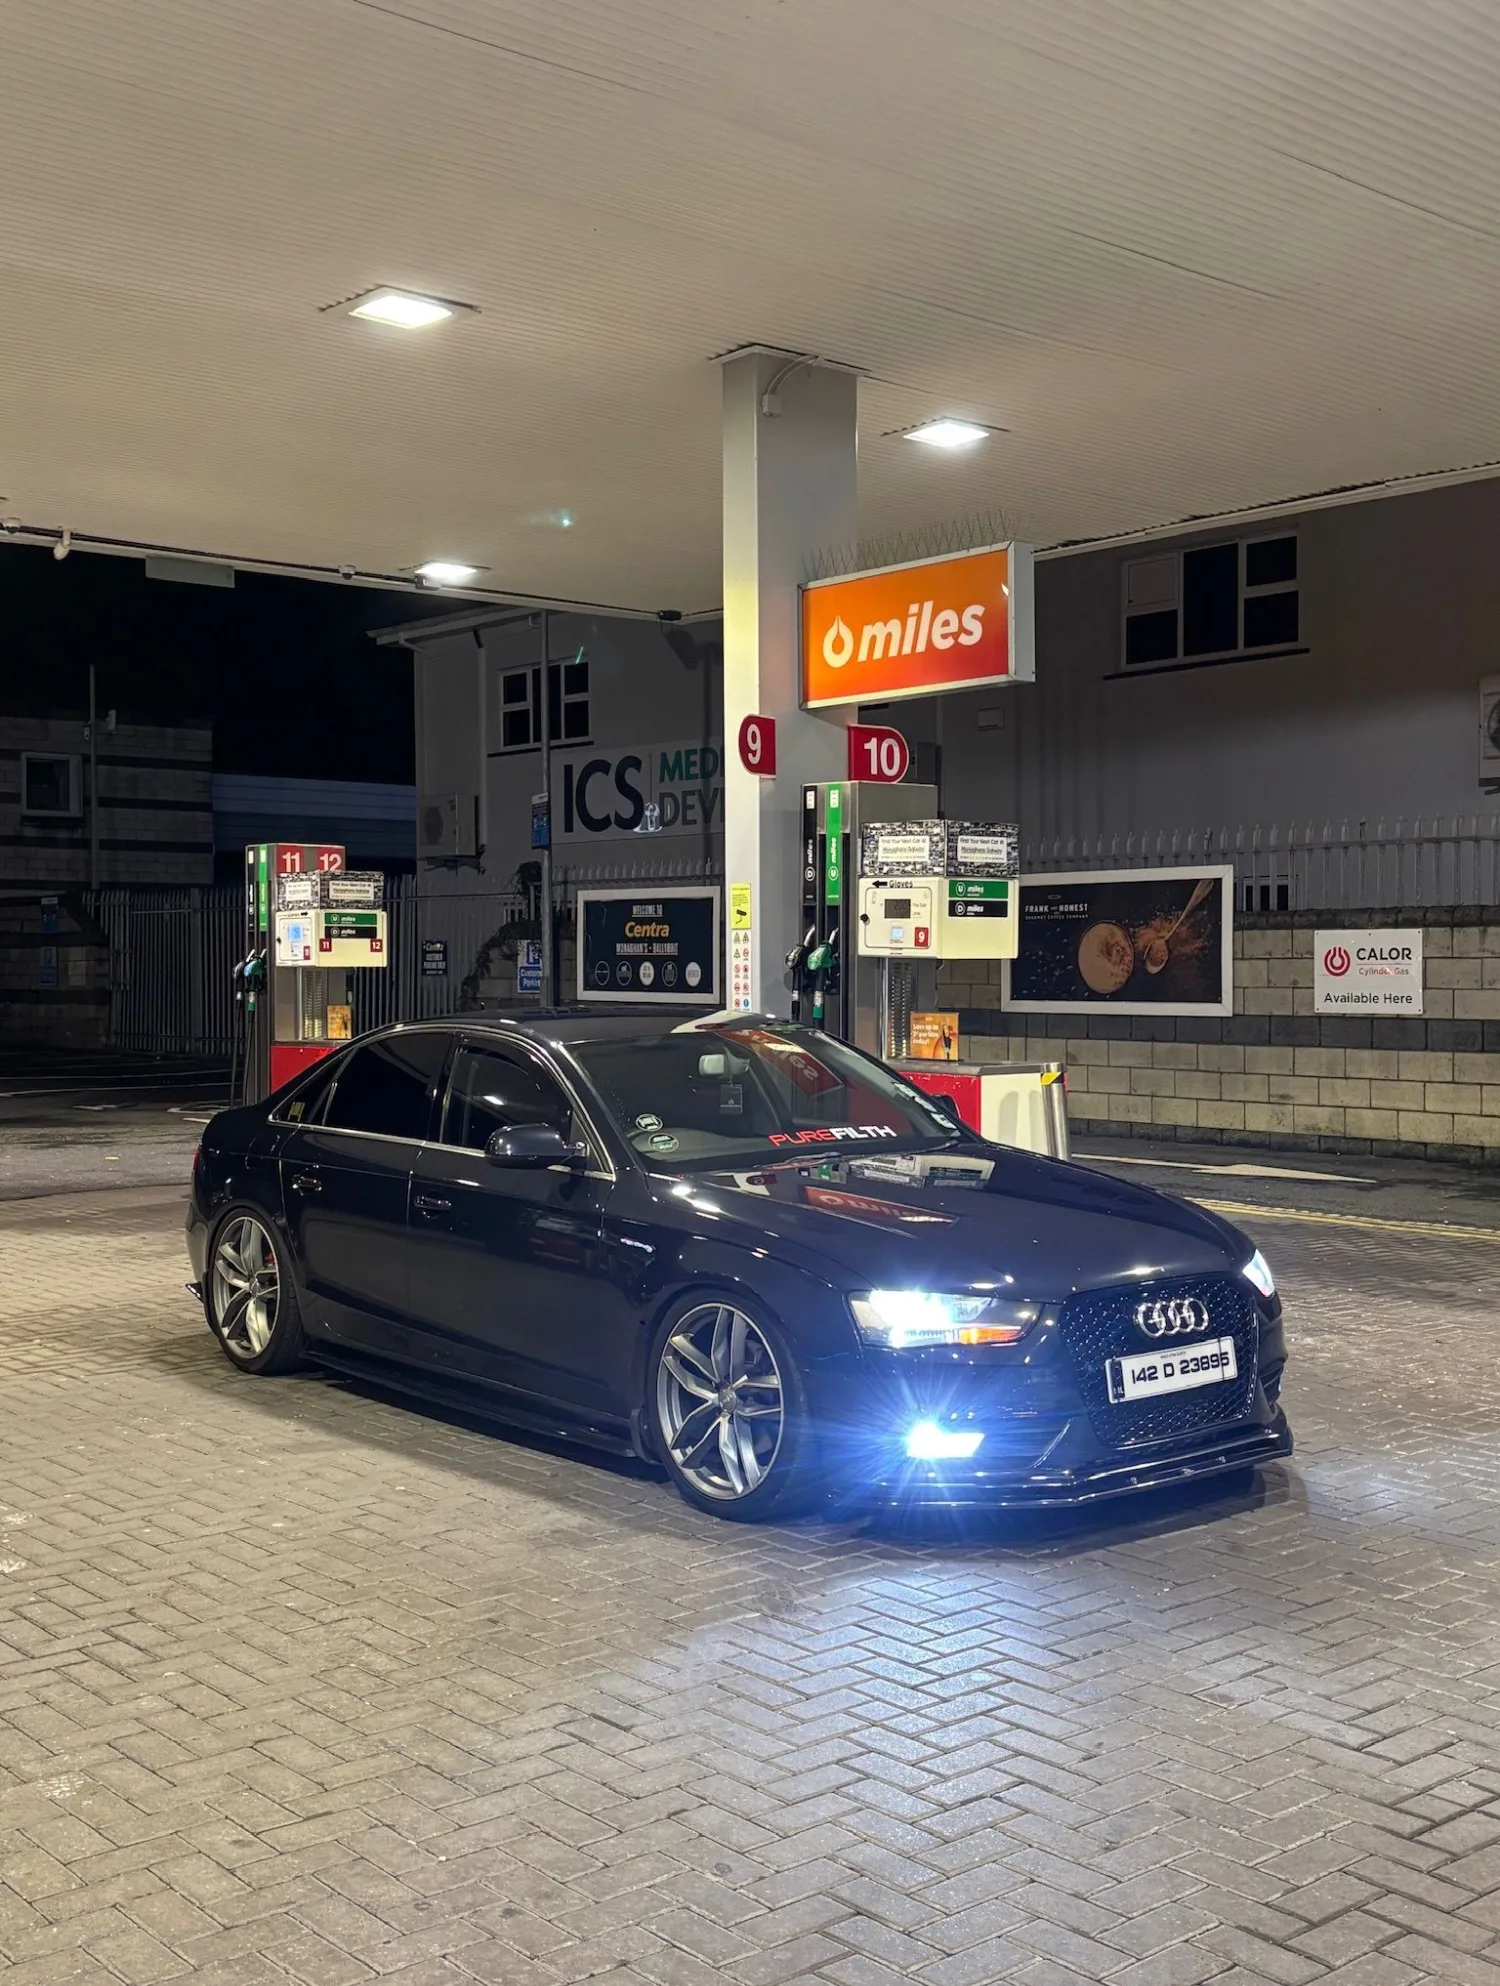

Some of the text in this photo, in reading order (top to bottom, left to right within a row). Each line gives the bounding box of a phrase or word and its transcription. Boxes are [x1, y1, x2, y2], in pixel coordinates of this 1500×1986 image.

[857, 600, 985, 662] miles
[747, 724, 761, 764] 9
[864, 737, 900, 776] 10
[564, 755, 643, 833] ICS
[282, 852, 300, 872] 11
[320, 854, 342, 872] 12
[889, 880, 913, 888] Gloves
[967, 904, 984, 912] miles
[625, 921, 670, 937] Centra
[918, 931, 925, 942] 9
[1356, 947, 1412, 960] CALOR
[1394, 967, 1409, 975] Gas
[1324, 992, 1413, 1003] Available Here
[768, 1125, 897, 1147] PUREFILTH
[1131, 1351, 1230, 1384] 142 D 23895
